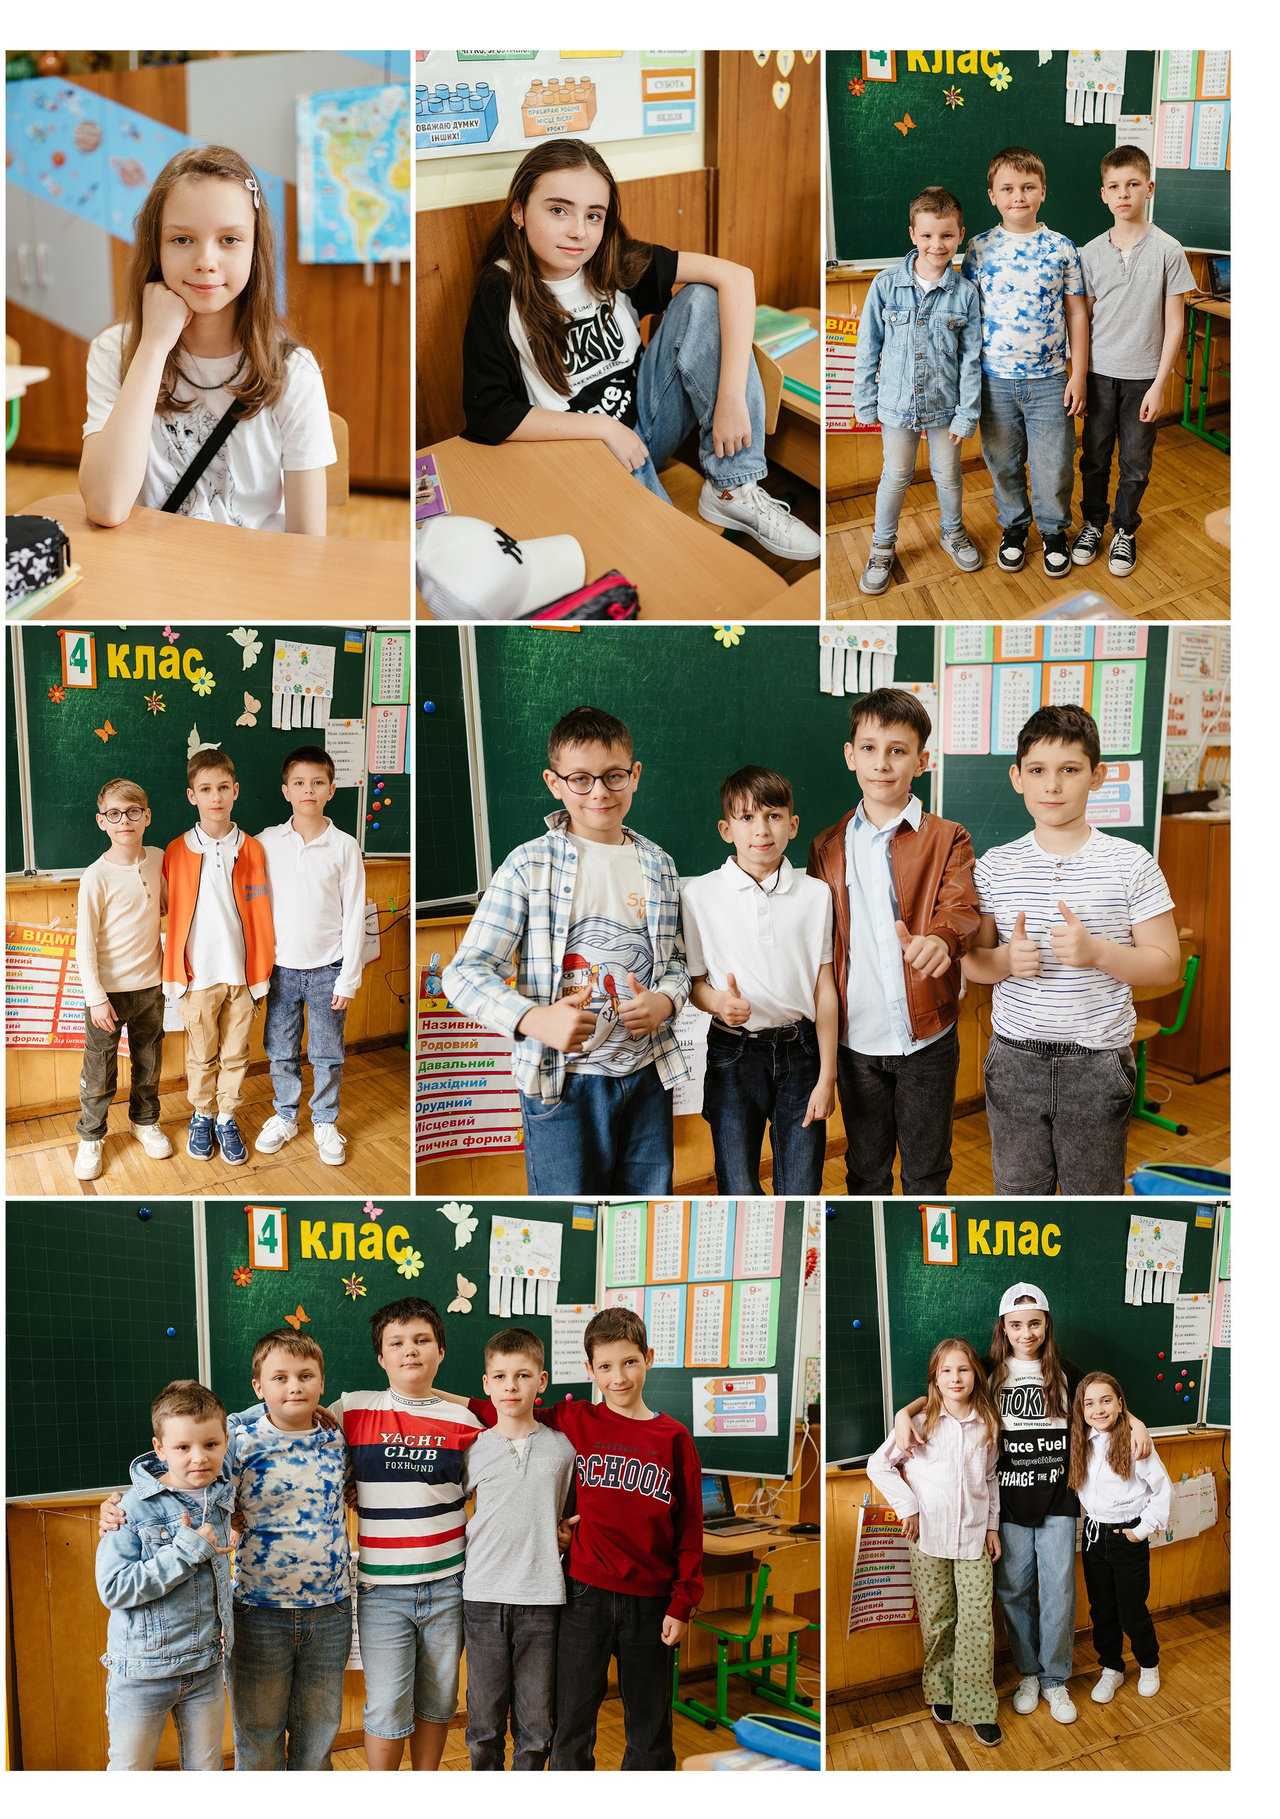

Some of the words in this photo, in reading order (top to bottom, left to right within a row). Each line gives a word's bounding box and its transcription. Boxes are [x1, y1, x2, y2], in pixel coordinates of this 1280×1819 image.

[654, 81, 684, 89] СУБОТА
[453, 120, 479, 130] ДУМКУ
[431, 133, 460, 141] ІНШИХ!
[107, 643, 205, 680] клас
[422, 1020, 487, 1030] Називни
[12, 1035, 44, 1044] форма
[420, 1039, 479, 1051] Родовий
[418, 1059, 495, 1073] Давальний
[417, 1078, 487, 1092] Знахідний
[416, 1139, 458, 1154] лична
[463, 1135, 511, 1147] форма
[300, 1220, 411, 1262] клас
[930, 1211, 949, 1250] 4
[967, 1218, 1062, 1257] клас
[1000, 1387, 1046, 1417] TOKY
[380, 1432, 446, 1446] YACHT
[1037, 1436, 1066, 1451] Fuel
[384, 1446, 438, 1461] CLUB
[595, 1441, 638, 1454] ALLERGIC
[647, 1449, 656, 1457] TO
[576, 1454, 671, 1504] SCHOOL
[876, 1612, 906, 1621] форма
